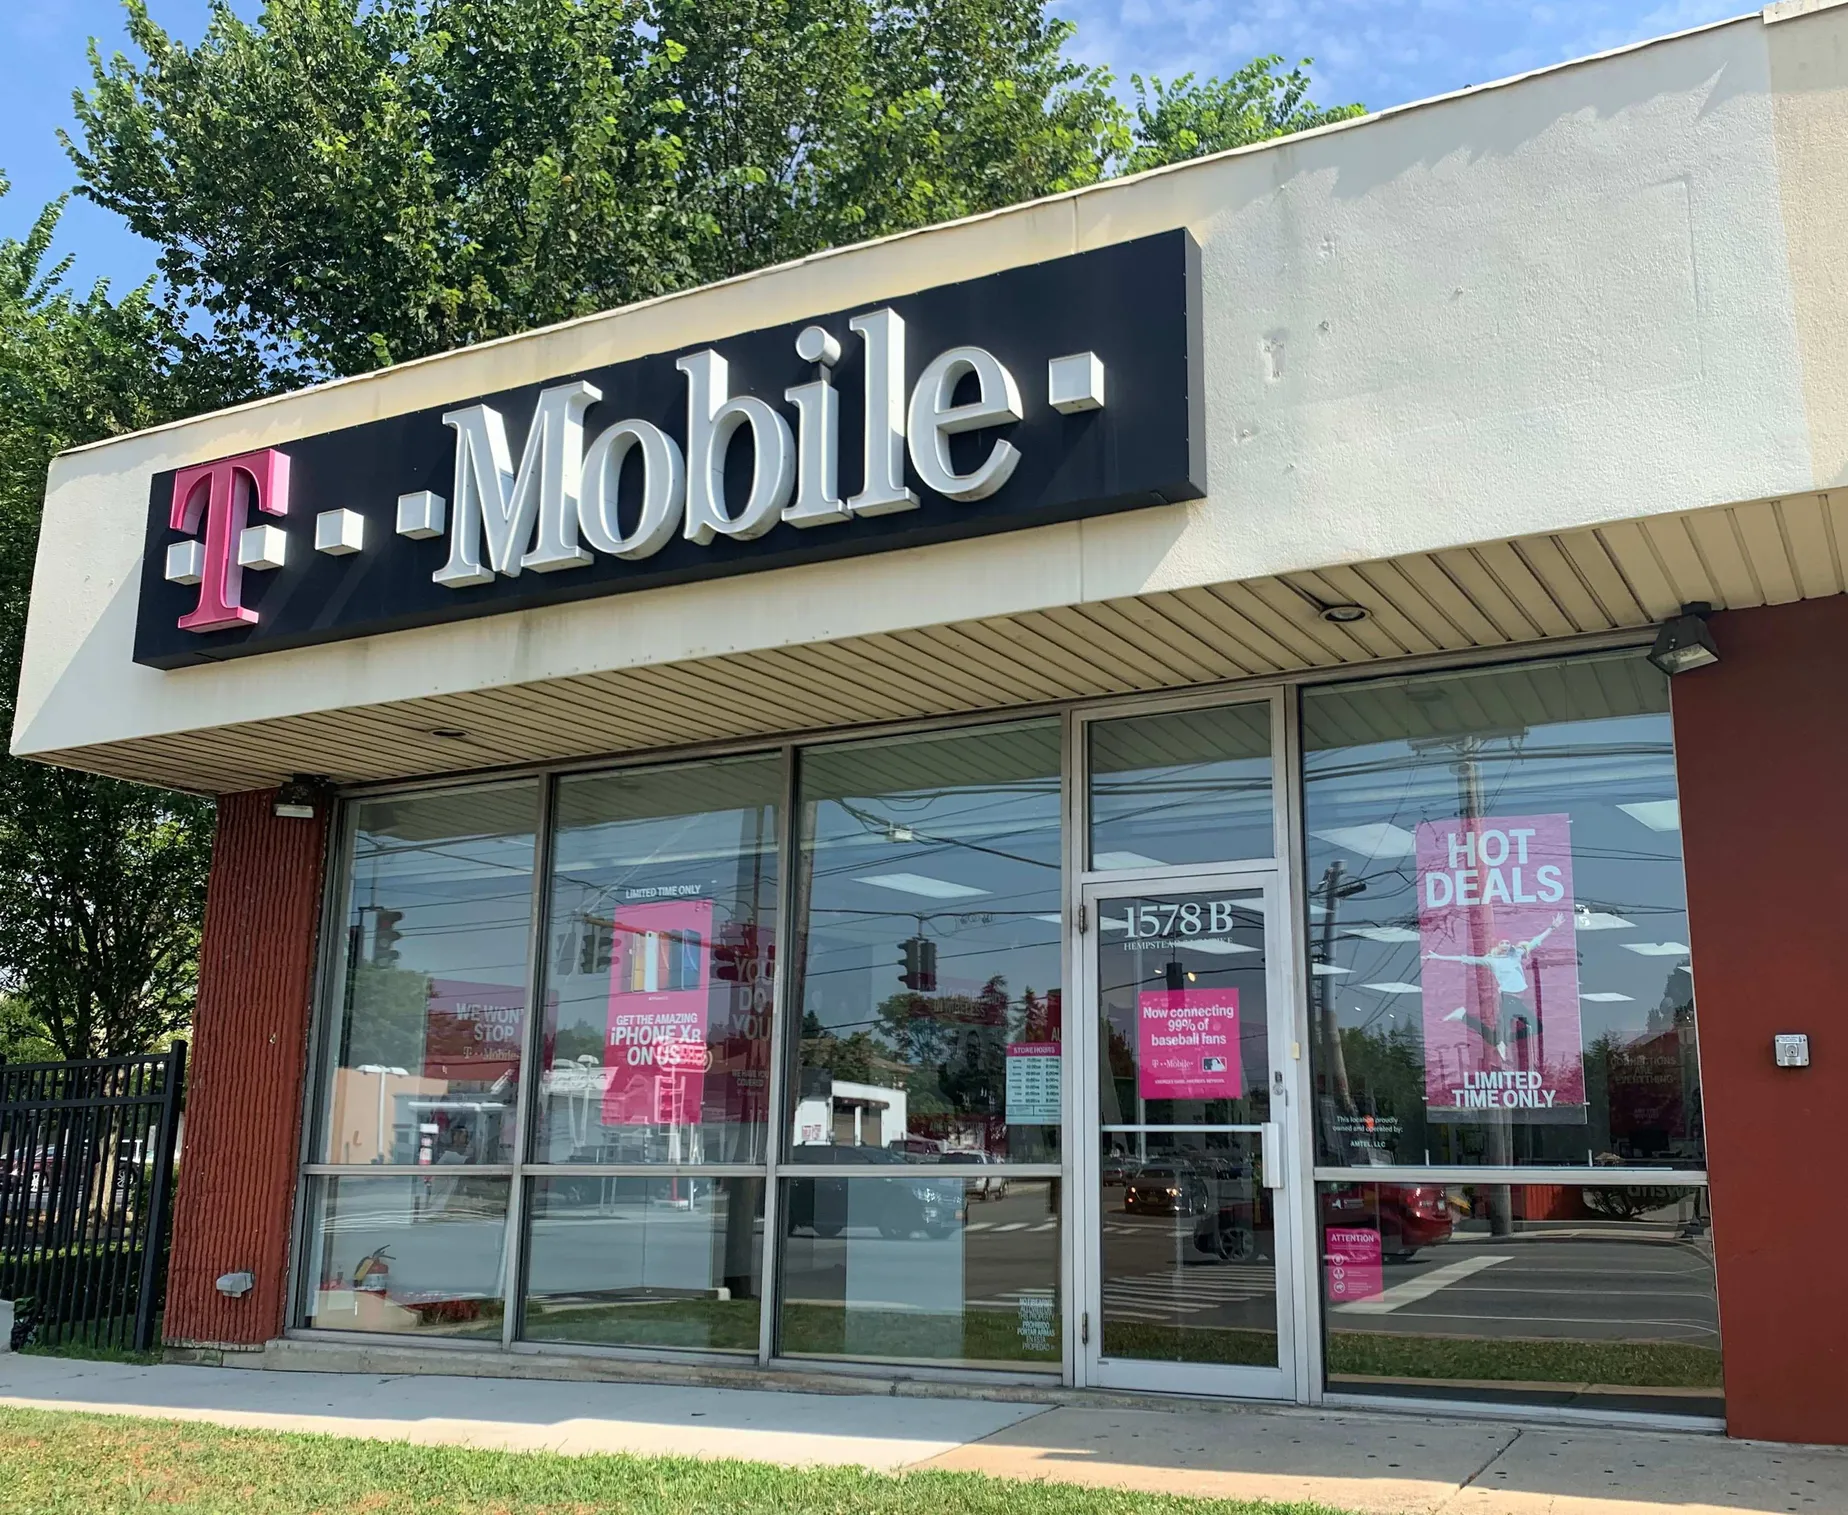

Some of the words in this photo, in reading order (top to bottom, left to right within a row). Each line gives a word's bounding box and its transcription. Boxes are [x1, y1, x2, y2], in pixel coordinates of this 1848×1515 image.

[1447, 828, 1536, 868] HOT
[625, 886, 657, 899] LIMITED
[657, 885, 678, 896] TIME
[678, 884, 701, 895] ONLY
[1425, 865, 1565, 908] DEALS
[1123, 902, 1202, 938] 1578
[1206, 901, 1234, 934] B
[456, 1003, 480, 1021] WE
[616, 1014, 636, 1026] GET
[636, 1014, 655, 1025] THE
[655, 1012, 698, 1025] AMAZING
[1143, 1006, 1168, 1018] Now
[1170, 1004, 1234, 1018] connecting
[474, 1024, 515, 1043] STOP
[1168, 1018, 1196, 1032] 99%
[1197, 1017, 1210, 1030] of
[610, 1024, 677, 1046] iPHONE
[1151, 1032, 1200, 1046] baseball
[1201, 1032, 1227, 1045] fans
[627, 1046, 653, 1066] ON
[656, 1045, 682, 1066] US
[1463, 1070, 1543, 1090] LIMITED
[1452, 1090, 1500, 1108] TIME
[1502, 1090, 1556, 1108] ONLY
[1331, 1234, 1374, 1242] ATTENTION
